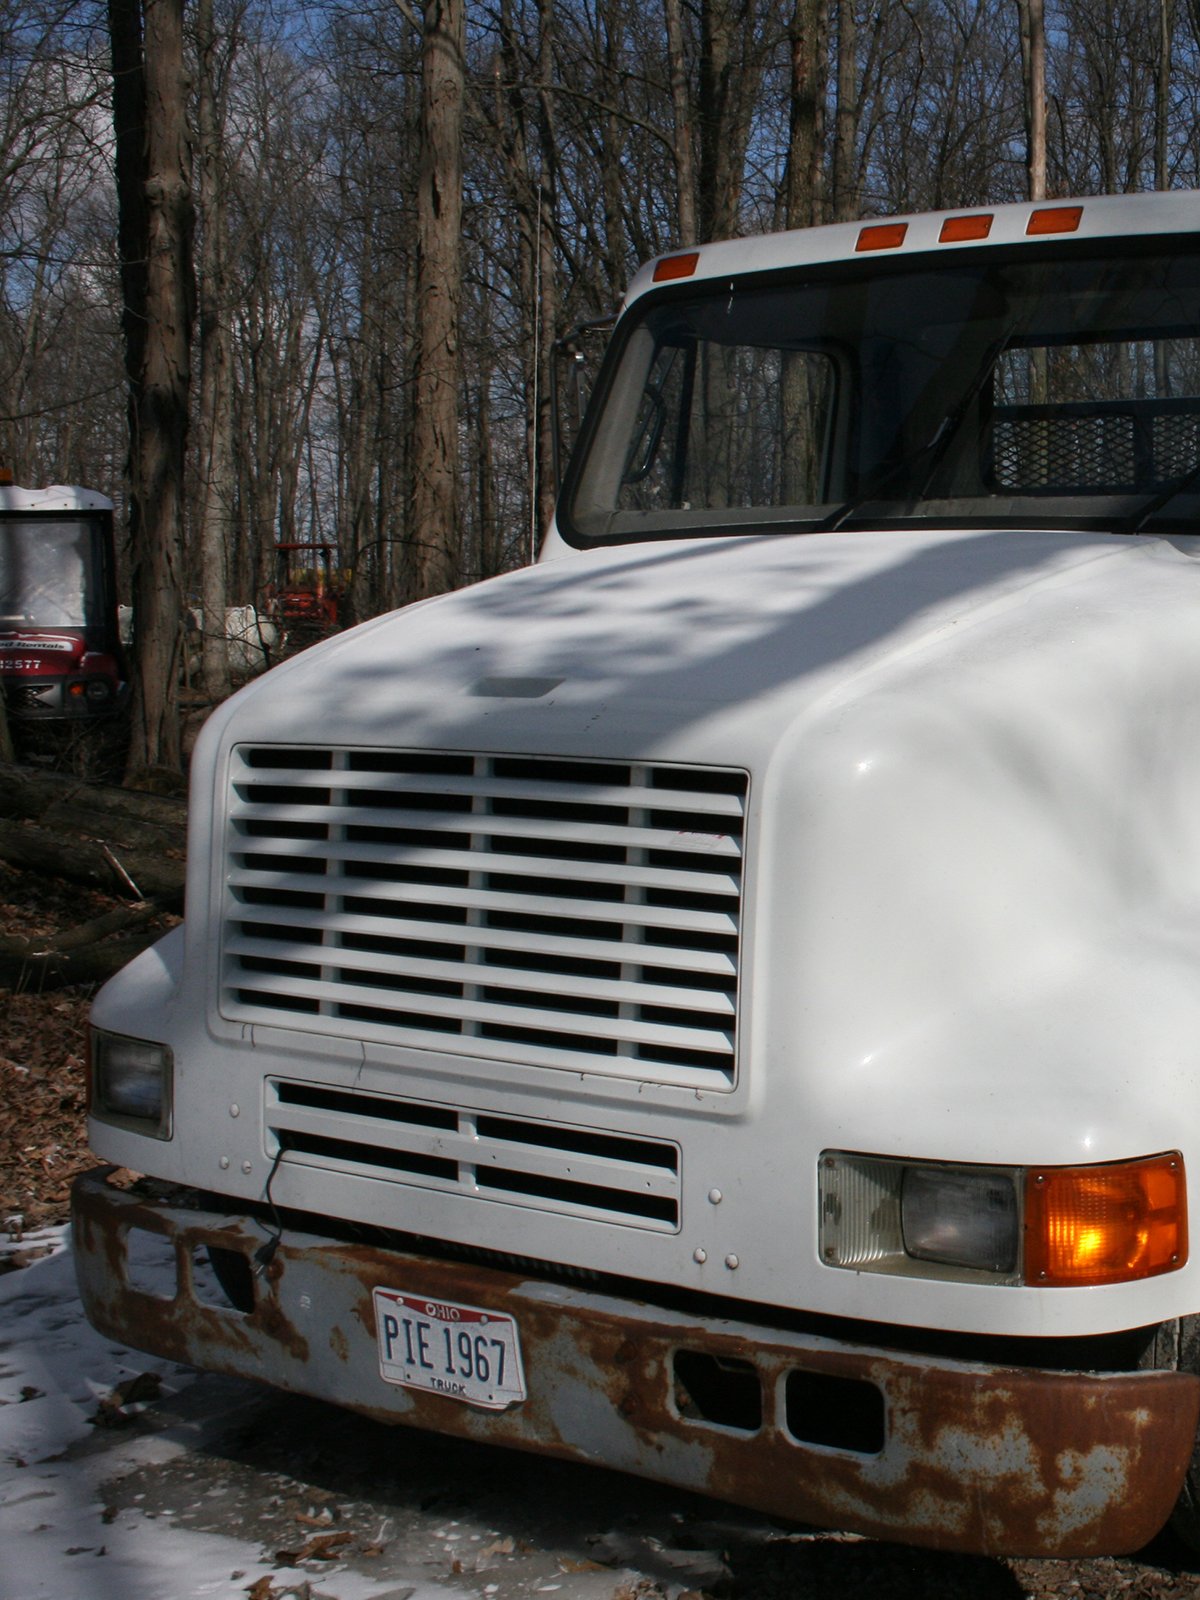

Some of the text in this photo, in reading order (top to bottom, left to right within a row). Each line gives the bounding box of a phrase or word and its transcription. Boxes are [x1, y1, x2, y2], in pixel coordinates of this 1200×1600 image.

[17, 642, 64, 650] Rentals
[425, 1303, 461, 1322] OHIO
[384, 1314, 506, 1386] PIE 1967
[430, 1377, 467, 1396] TRUCK
